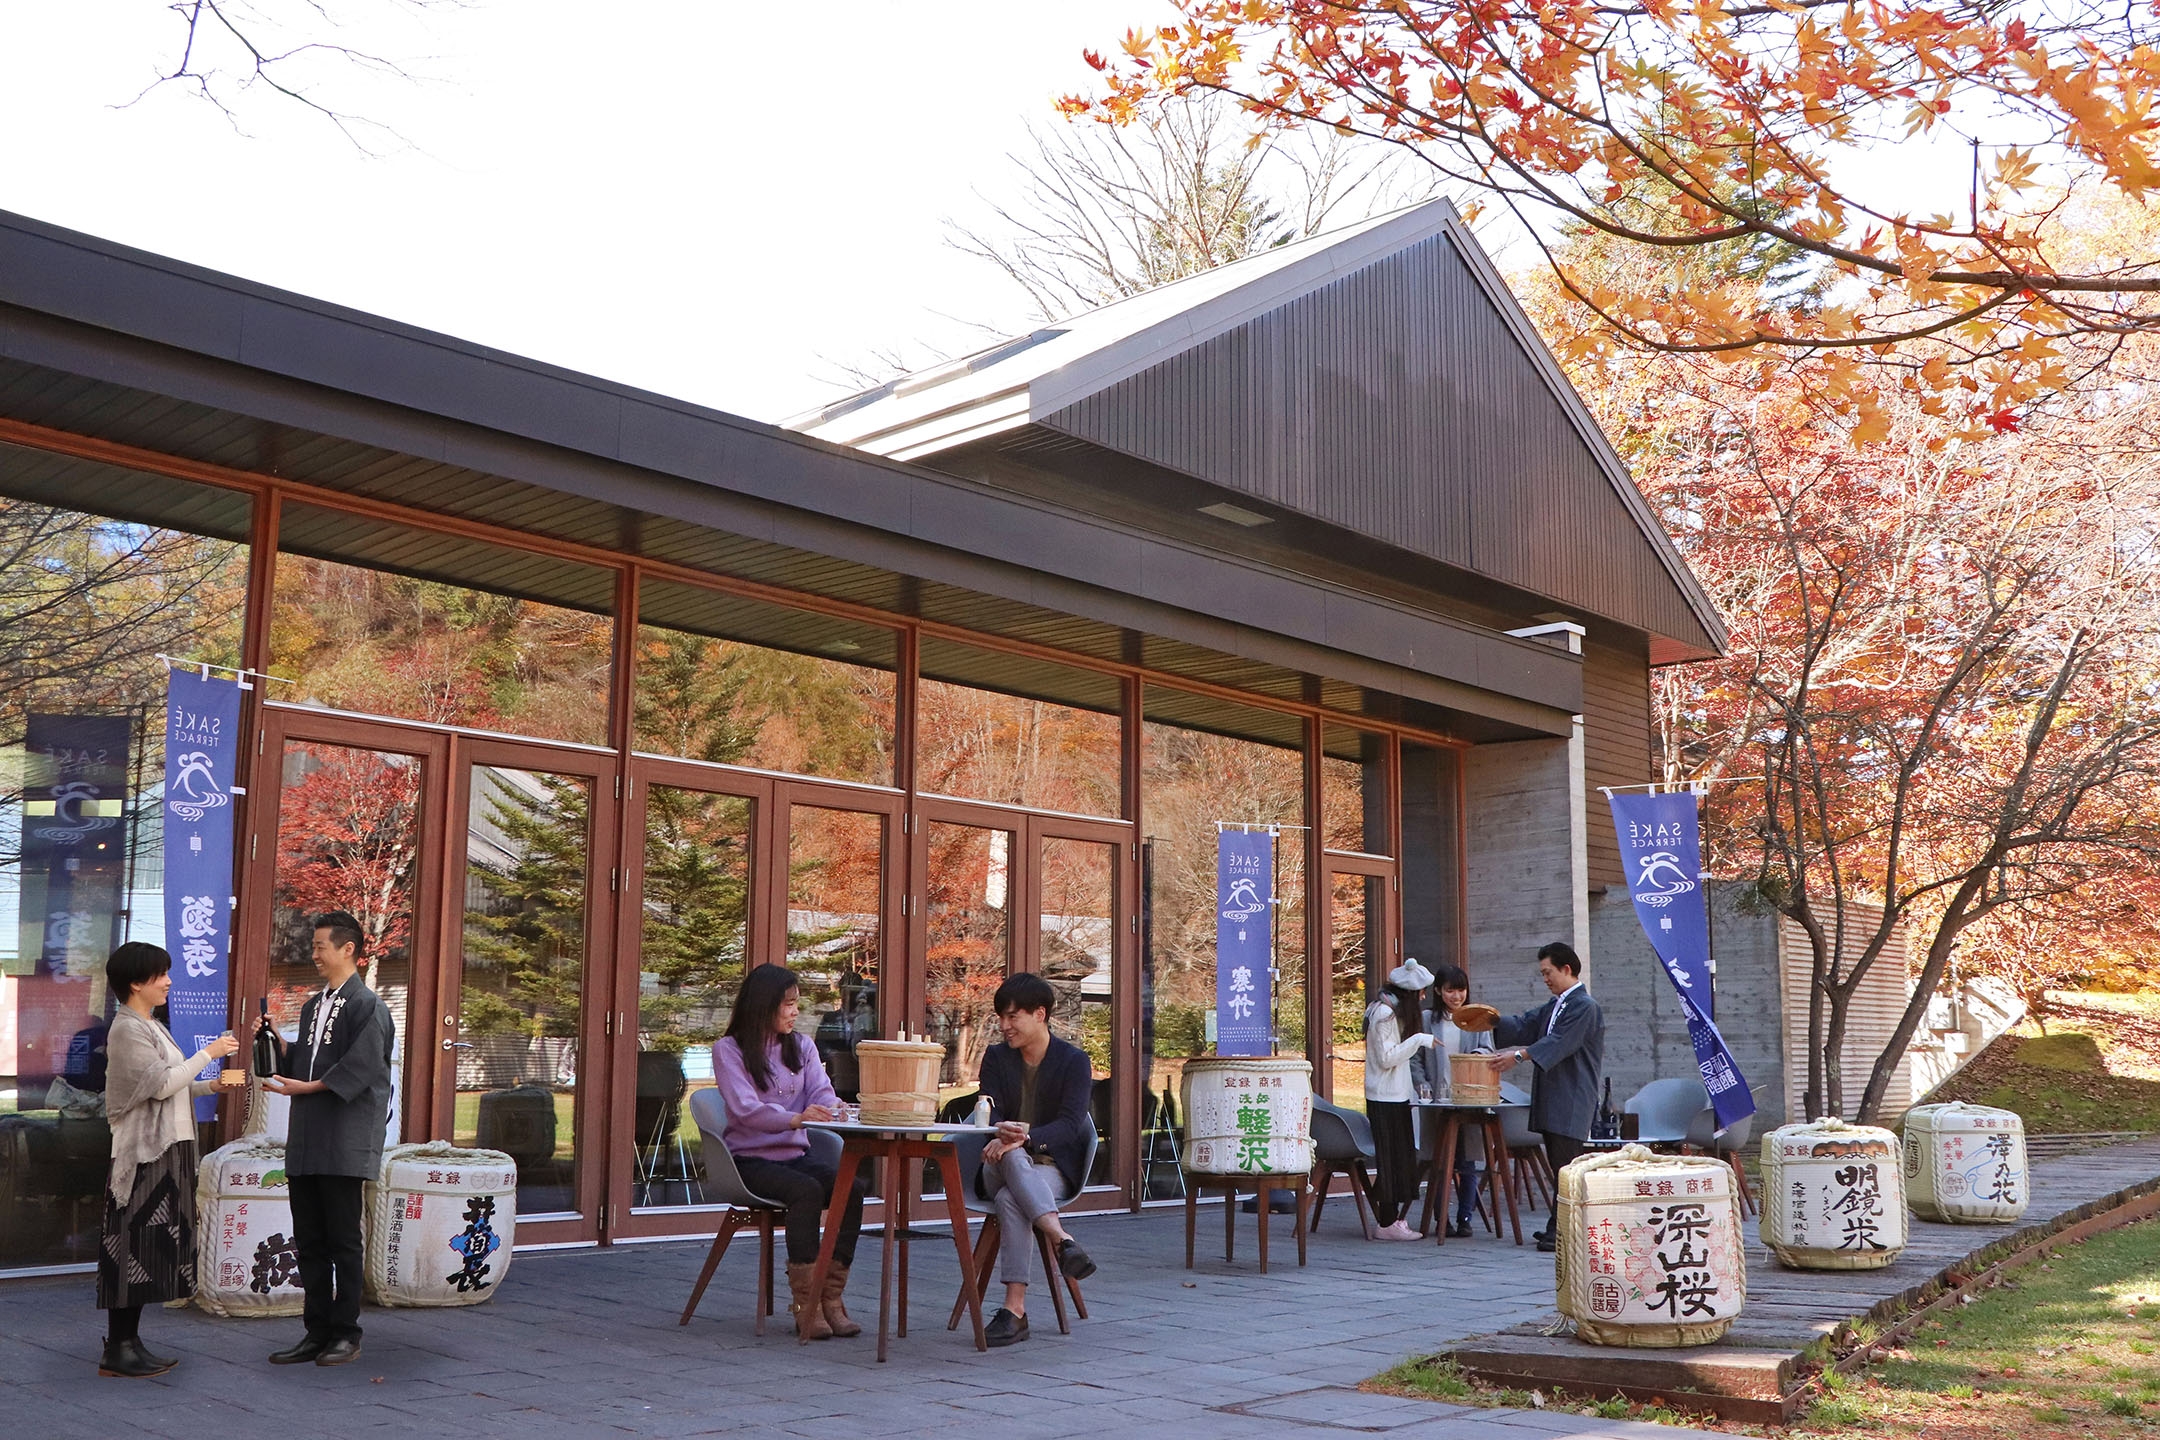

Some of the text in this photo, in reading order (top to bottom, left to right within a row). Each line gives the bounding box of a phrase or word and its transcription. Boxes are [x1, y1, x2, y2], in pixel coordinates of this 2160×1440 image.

[1236, 1106, 1273, 1172] 軽井沢
[230, 1173, 260, 1186] 登録
[427, 1170, 461, 1185] 登録
[1635, 1178, 1714, 1197] 登録 商標
[1645, 1203, 1719, 1319] 深山桜
[1604, 1283, 1620, 1313] 古屋
